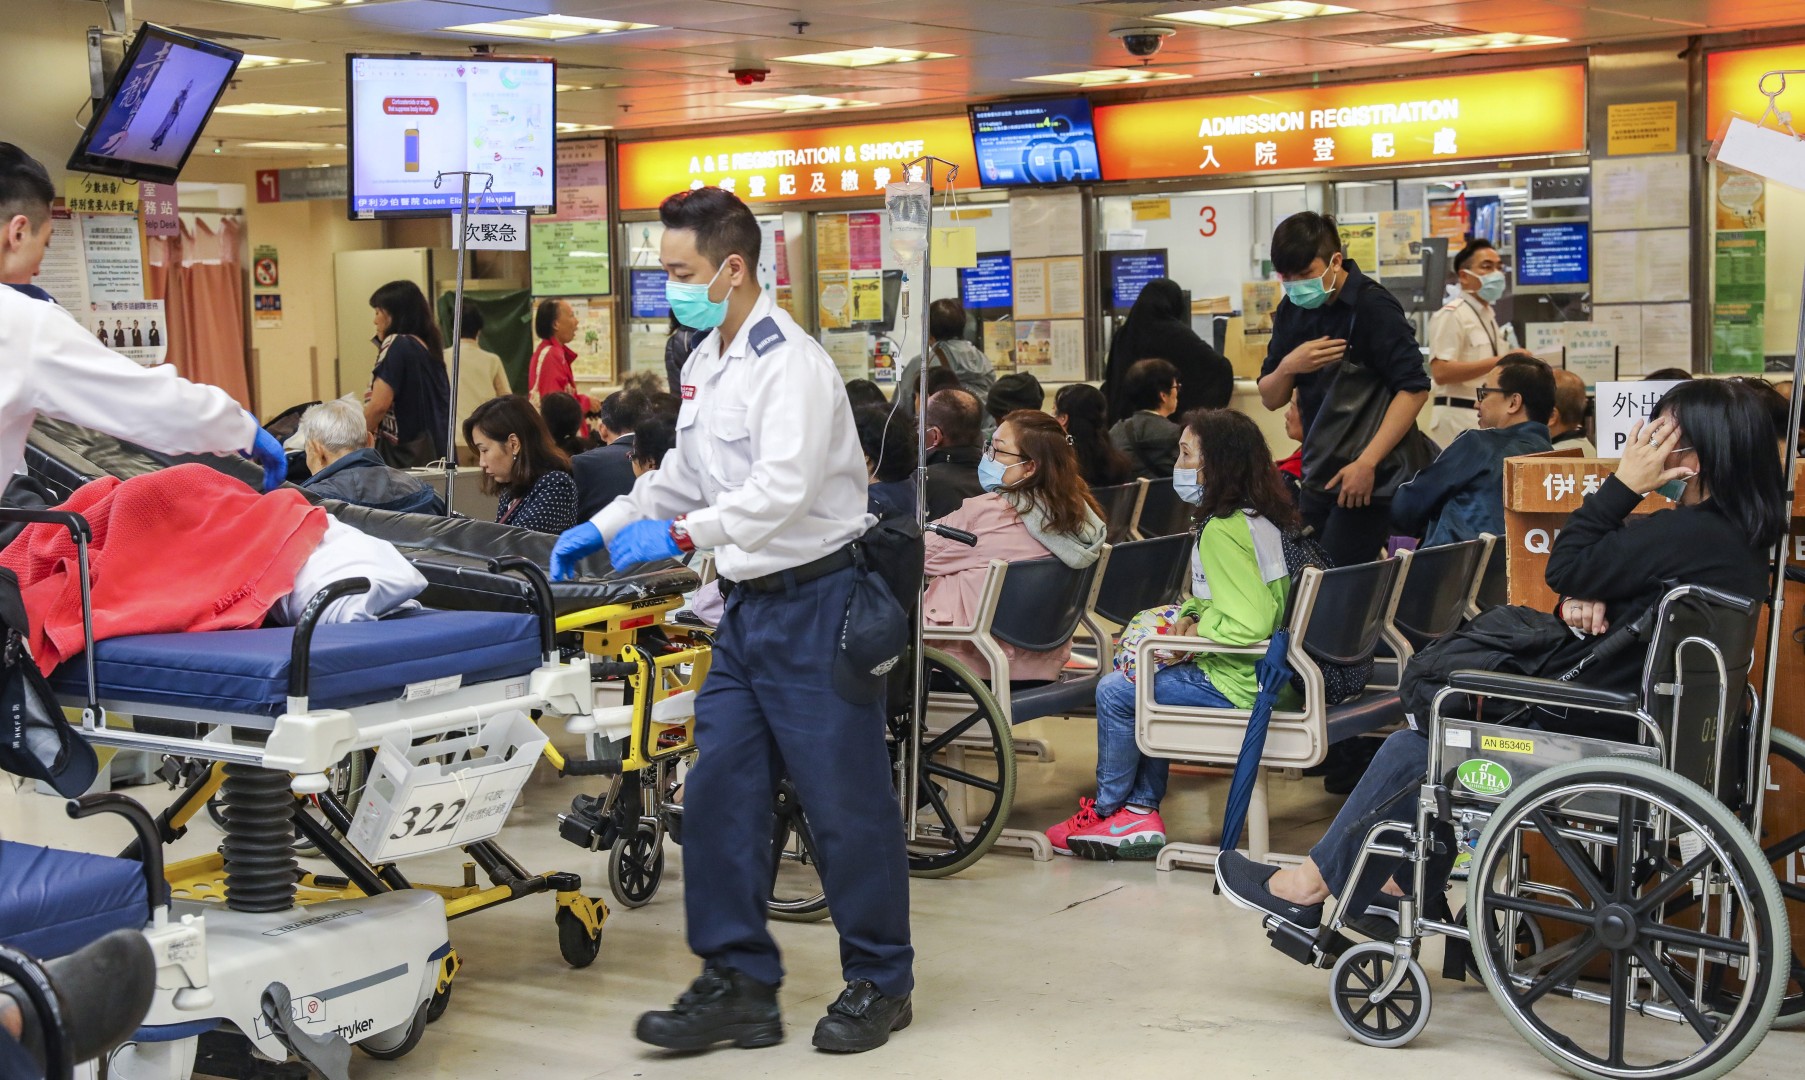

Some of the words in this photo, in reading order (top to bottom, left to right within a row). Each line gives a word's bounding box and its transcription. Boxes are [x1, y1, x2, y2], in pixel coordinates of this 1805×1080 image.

[1199, 111, 1304, 138] ADMISSION
[1310, 98, 1459, 130] REGISTRATION
[689, 156, 701, 174] A
[704, 155, 716, 173] &
[718, 153, 729, 172] E
[731, 145, 841, 171] REGISTRATION
[844, 145, 857, 163] &
[859, 140, 925, 162] SHROFF
[1199, 127, 1458, 170] 入院登記處
[357, 197, 421, 207] 伊利沙伯醫院
[423, 197, 446, 205] Queen
[1449, 192, 1470, 224] 4
[160, 220, 177, 229] Desk
[465, 223, 517, 242] 次緊急
[1199, 206, 1217, 237] 3
[1484, 739, 1497, 748] AN
[1499, 740, 1531, 752] 853405
[1461, 771, 1506, 790] ALPHA
[389, 798, 467, 840] 322
[277, 911, 347, 932] TRANSPORT
[331, 1018, 374, 1040] tryker
